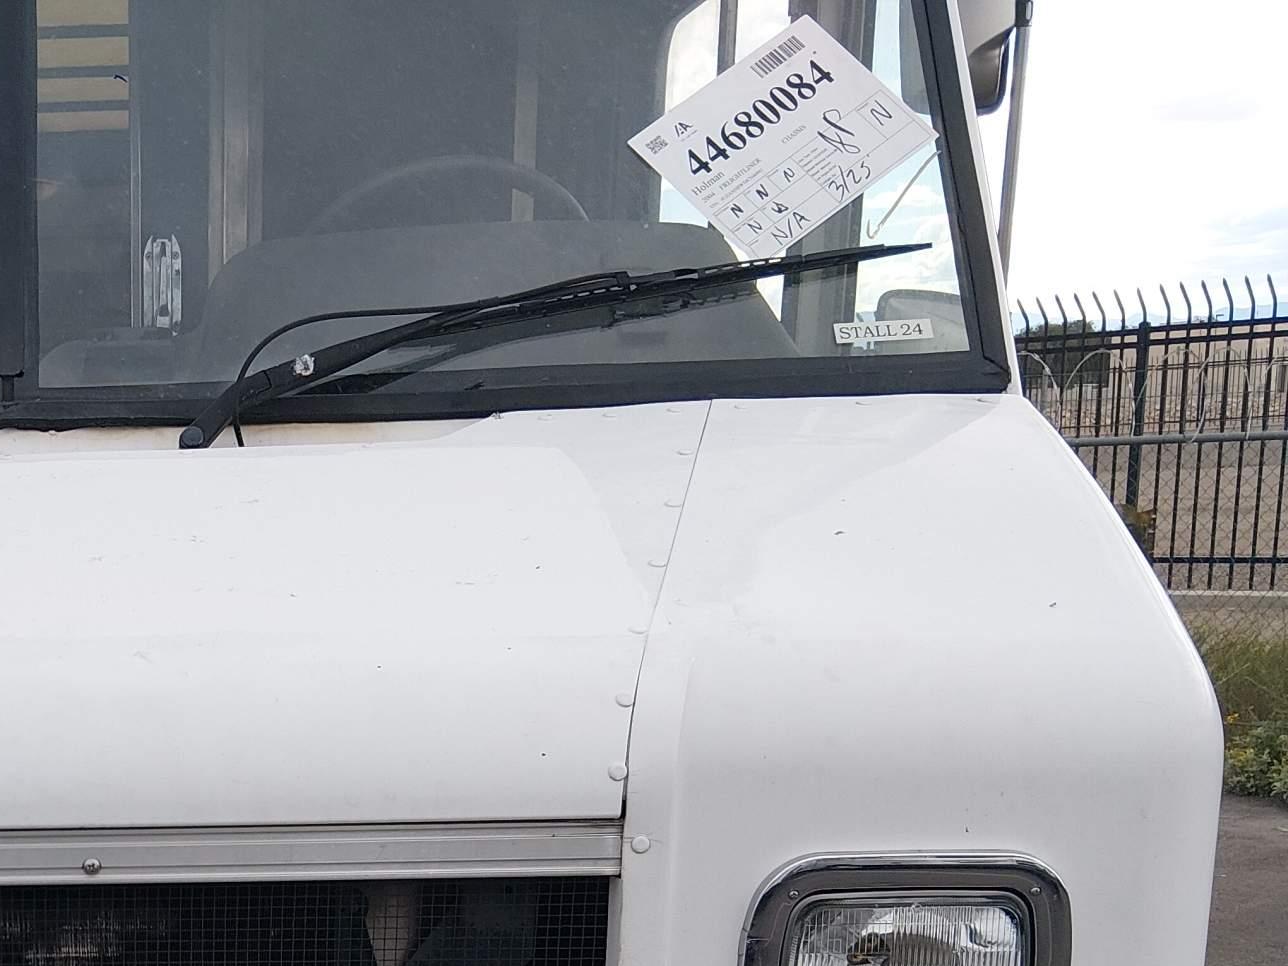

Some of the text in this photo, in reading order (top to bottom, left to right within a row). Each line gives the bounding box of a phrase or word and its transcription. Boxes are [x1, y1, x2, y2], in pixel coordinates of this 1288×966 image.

[686, 59, 834, 177] 44680084
[871, 100, 893, 127] N
[783, 167, 795, 183] N
[691, 171, 725, 196] Holman
[755, 184, 769, 200] N
[730, 203, 744, 219] N
[747, 220, 763, 234] N
[771, 212, 811, 246] N/A
[839, 323, 923, 339] STALL 24
